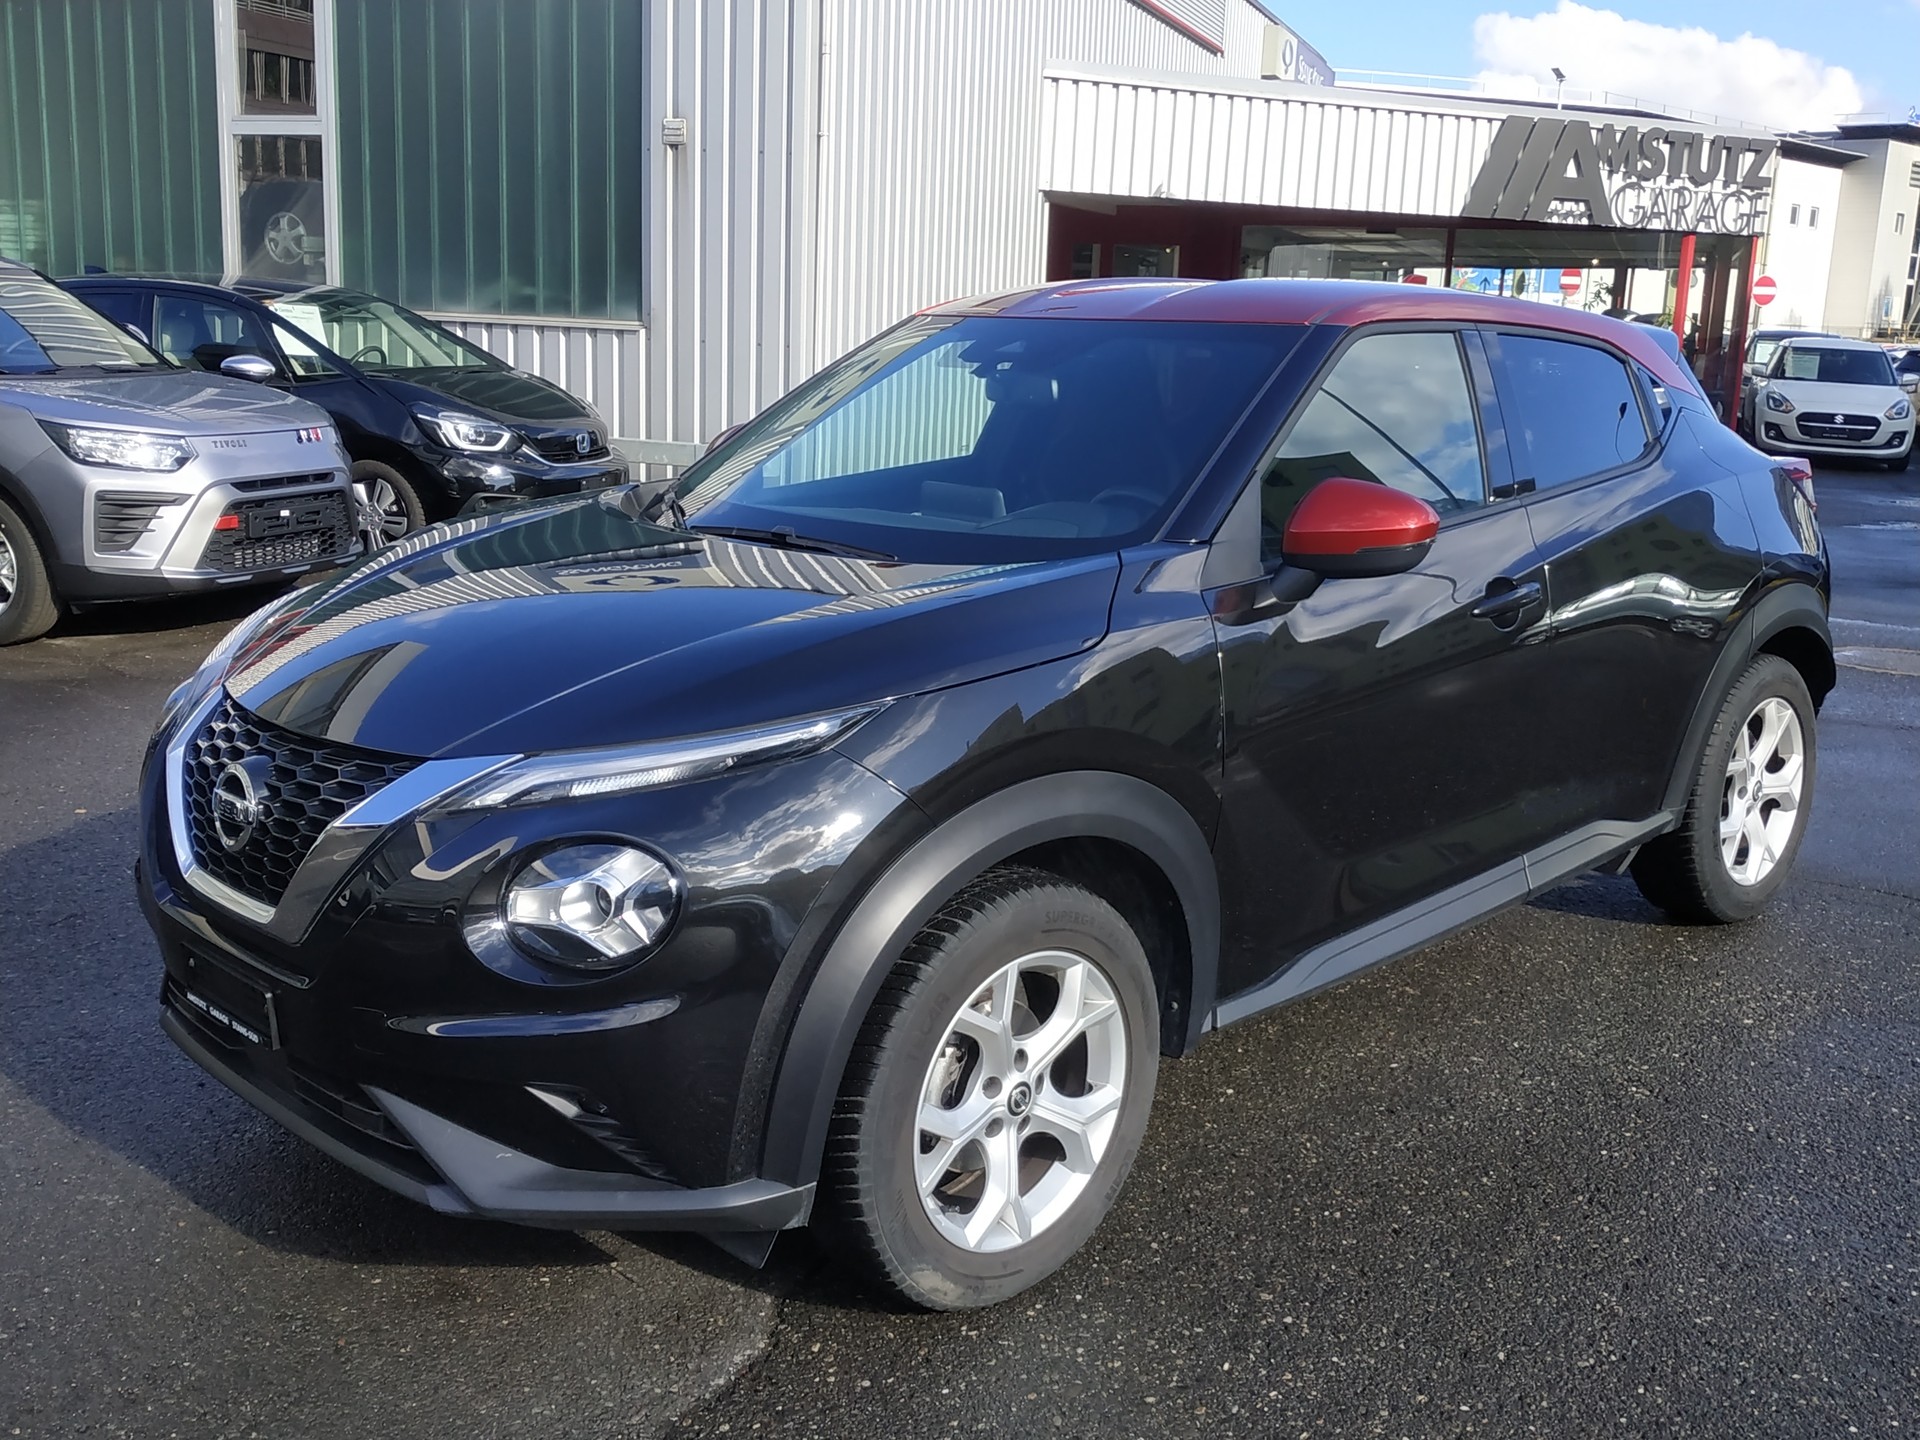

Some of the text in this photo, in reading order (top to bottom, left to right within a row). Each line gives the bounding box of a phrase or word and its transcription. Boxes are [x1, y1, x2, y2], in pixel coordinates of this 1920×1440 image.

[1517, 118, 1778, 226] AMSTUTZ
[1611, 181, 1770, 236] GARAGE
[211, 439, 248, 449] TIVOLI
